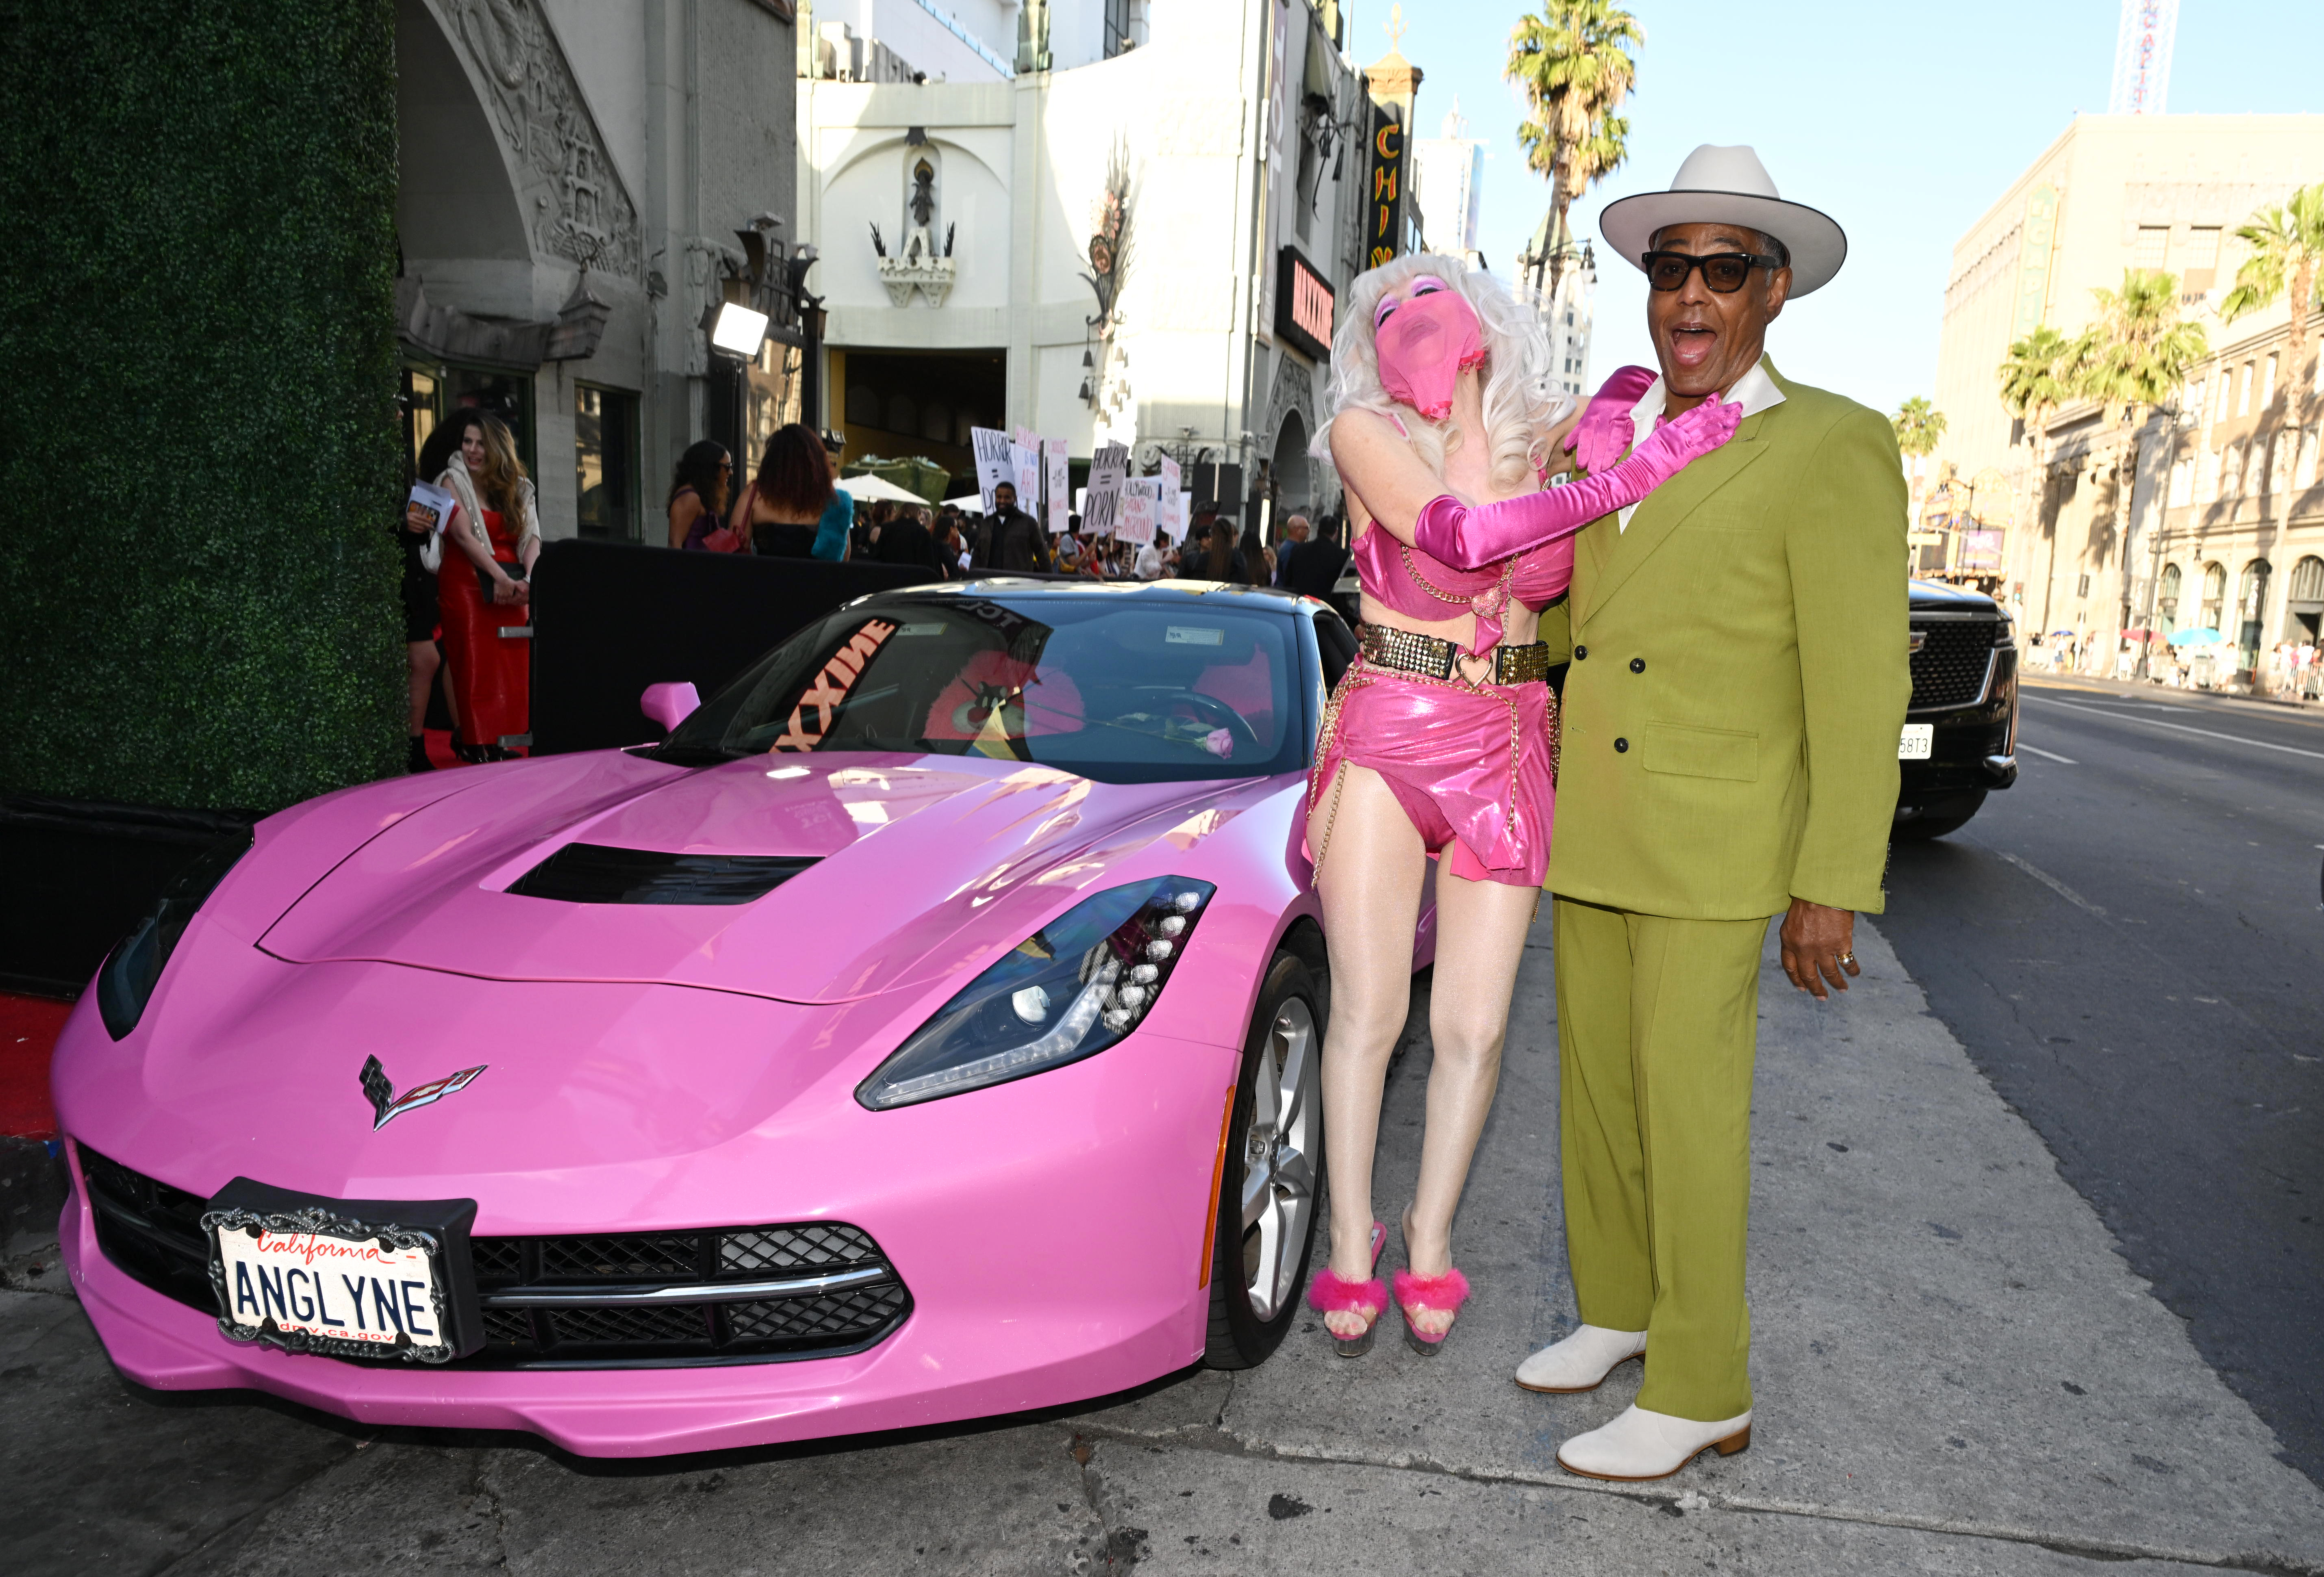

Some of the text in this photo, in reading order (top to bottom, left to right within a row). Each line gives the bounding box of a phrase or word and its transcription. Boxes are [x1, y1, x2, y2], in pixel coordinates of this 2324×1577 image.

[2133, 14, 2157, 114] CAPIT
[1293, 259, 1334, 351] MAXXXINE
[975, 429, 1012, 465] HORROR
[1093, 447, 1129, 470] HORROR
[1021, 468, 1035, 495] ART
[1083, 487, 1120, 529] PORN
[768, 619, 895, 753] XXINE
[1900, 738, 1928, 753] 58T3
[256, 1228, 396, 1265] California
[236, 1260, 434, 1336] ANGLYNE
[280, 1323, 394, 1341] dmv.ca.gov
